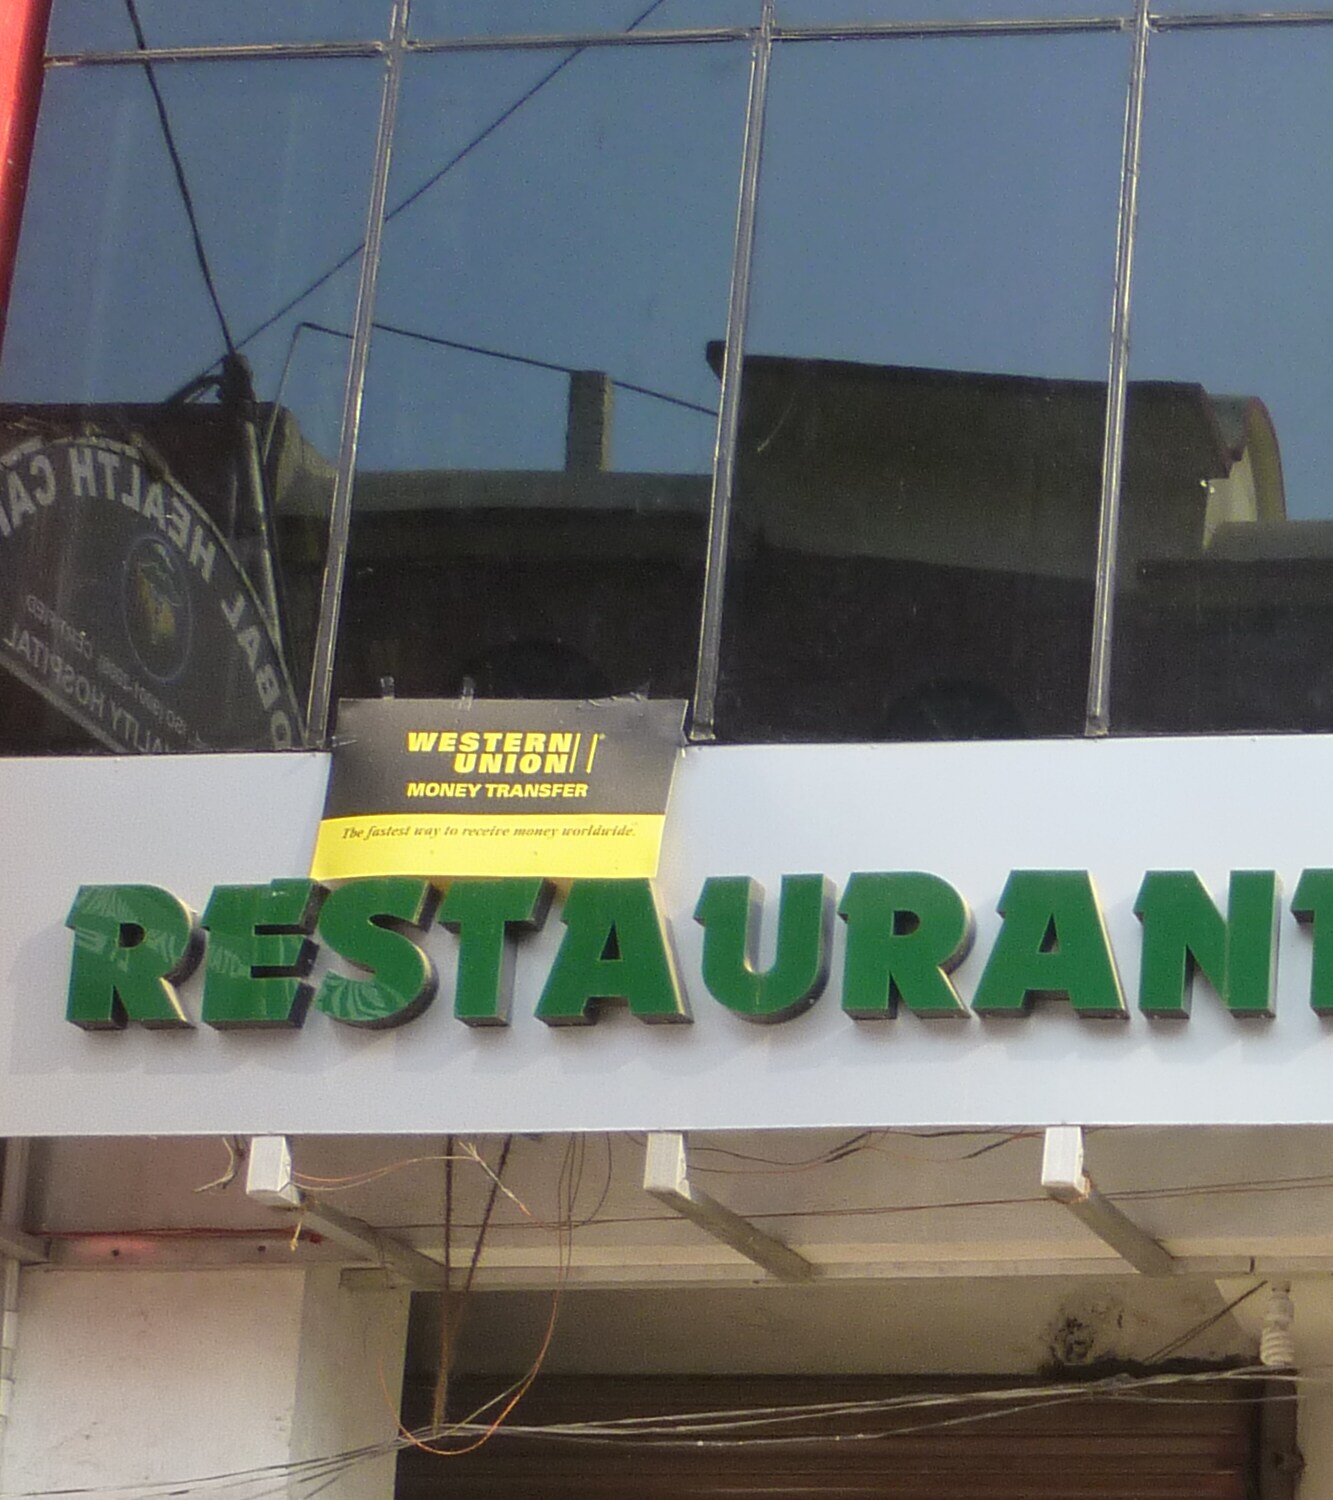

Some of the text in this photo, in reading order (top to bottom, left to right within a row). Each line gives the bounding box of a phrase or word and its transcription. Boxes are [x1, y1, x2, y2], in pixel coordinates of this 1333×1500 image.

[406, 731, 575, 753] WESTERN
[453, 753, 571, 774] UNION
[405, 782, 590, 799] MONEY TRANSFER
[342, 826, 363, 840] The
[364, 824, 410, 842] fastest
[414, 827, 441, 838] way
[445, 825, 459, 837] to
[463, 827, 511, 838] receive
[513, 827, 557, 839] money
